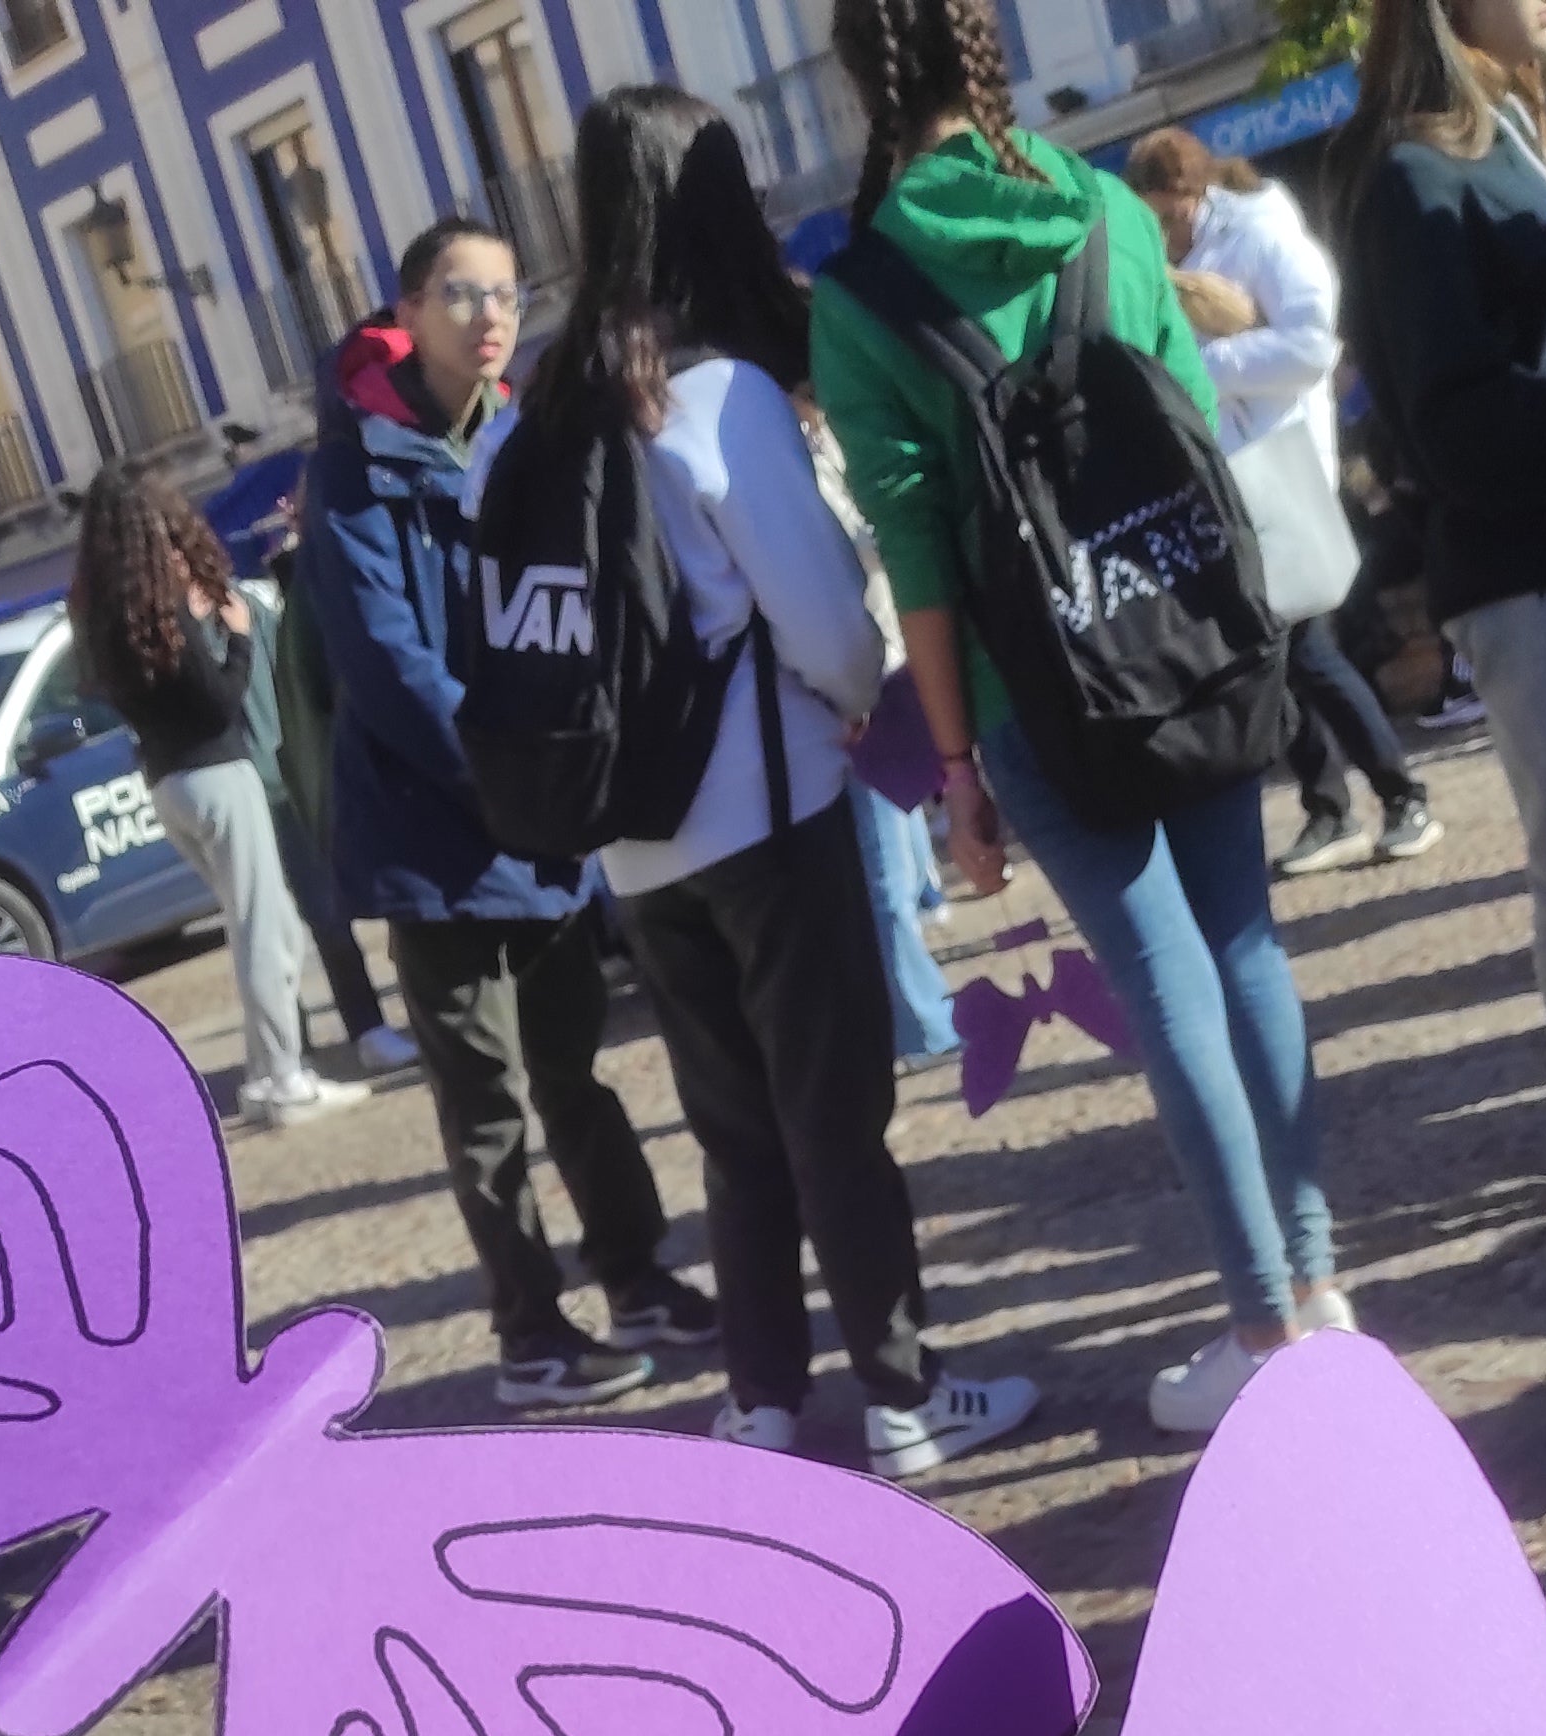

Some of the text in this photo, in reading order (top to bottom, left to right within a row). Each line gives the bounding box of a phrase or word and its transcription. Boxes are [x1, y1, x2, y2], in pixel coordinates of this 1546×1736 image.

[1051, 481, 1228, 635] VANS
[479, 555, 594, 657] VAN
[72, 770, 154, 829] POL
[83, 804, 167, 865] NAC
